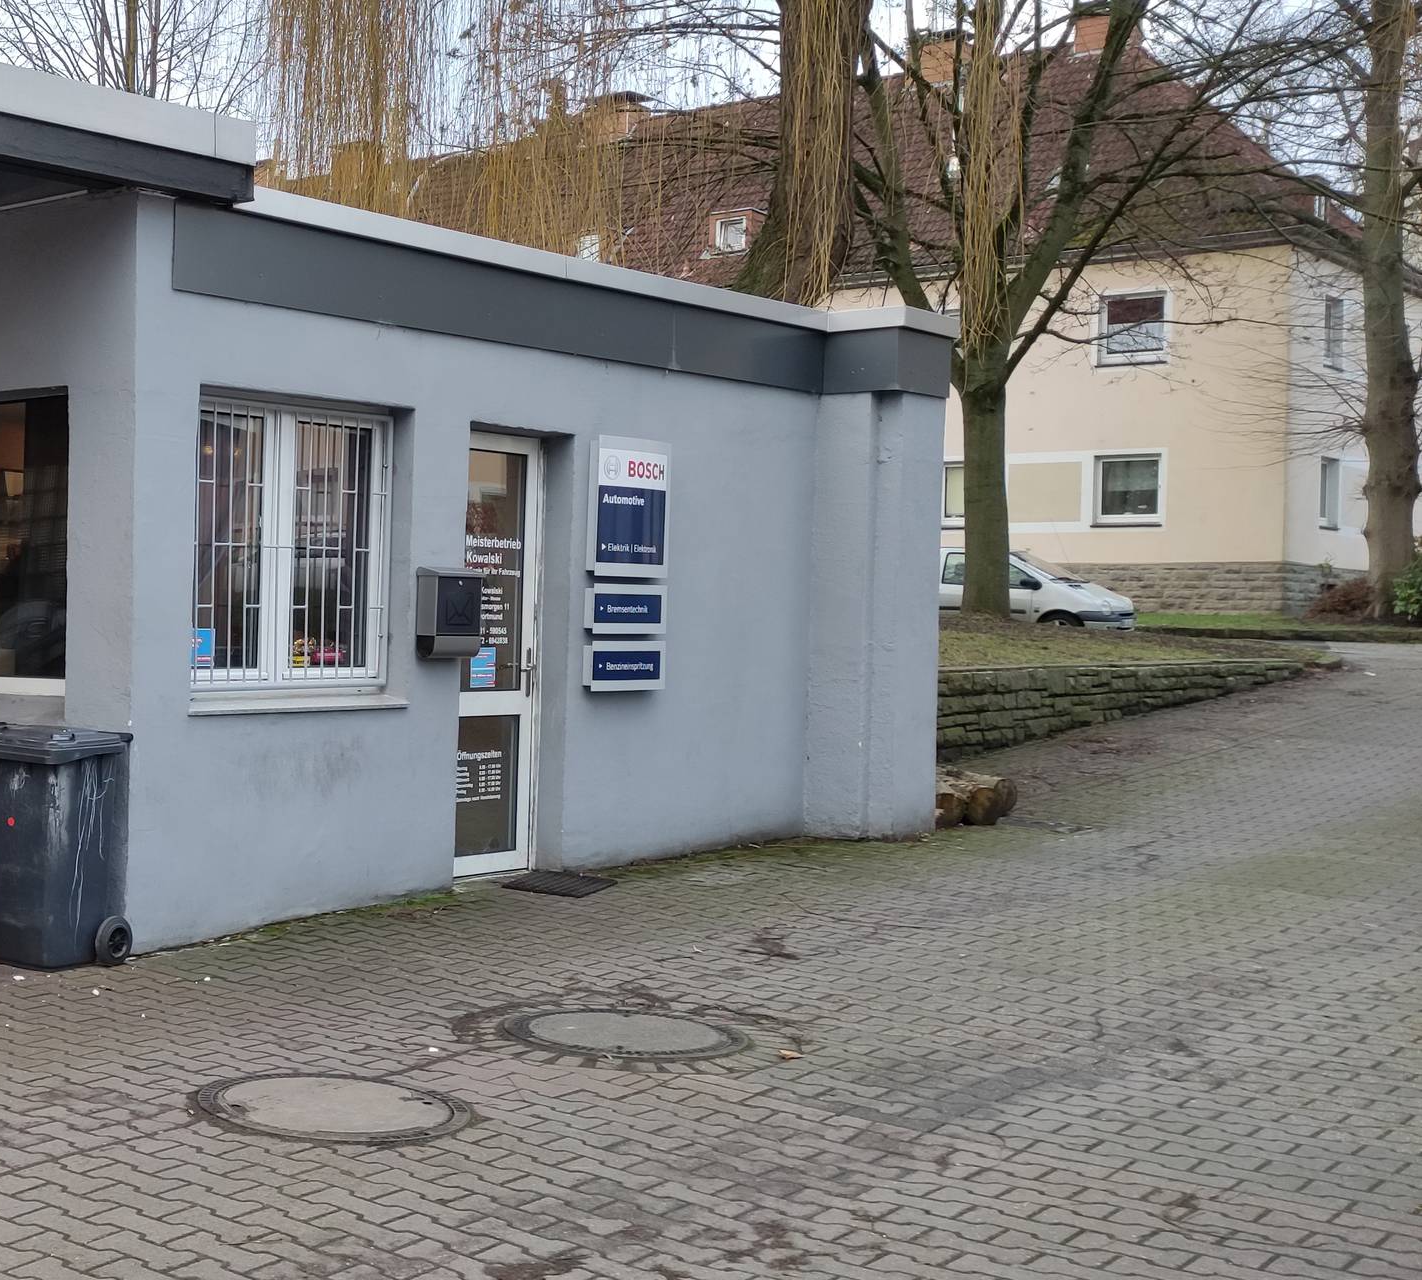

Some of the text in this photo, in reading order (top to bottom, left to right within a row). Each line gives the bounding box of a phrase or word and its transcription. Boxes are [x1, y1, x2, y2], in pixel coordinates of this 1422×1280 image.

[628, 460, 665, 481] BOSCH
[602, 493, 645, 506] Automotive
[466, 534, 522, 550] Meisterbetrieb
[607, 542, 630, 553] Elektrik
[633, 544, 657, 554] Elektronik
[466, 551, 503, 564] Kowalski
[607, 604, 648, 614] Bremsentechnik
[606, 661, 654, 671] Benzineinspritzung
[456, 750, 502, 761] Öffnungszeiten
